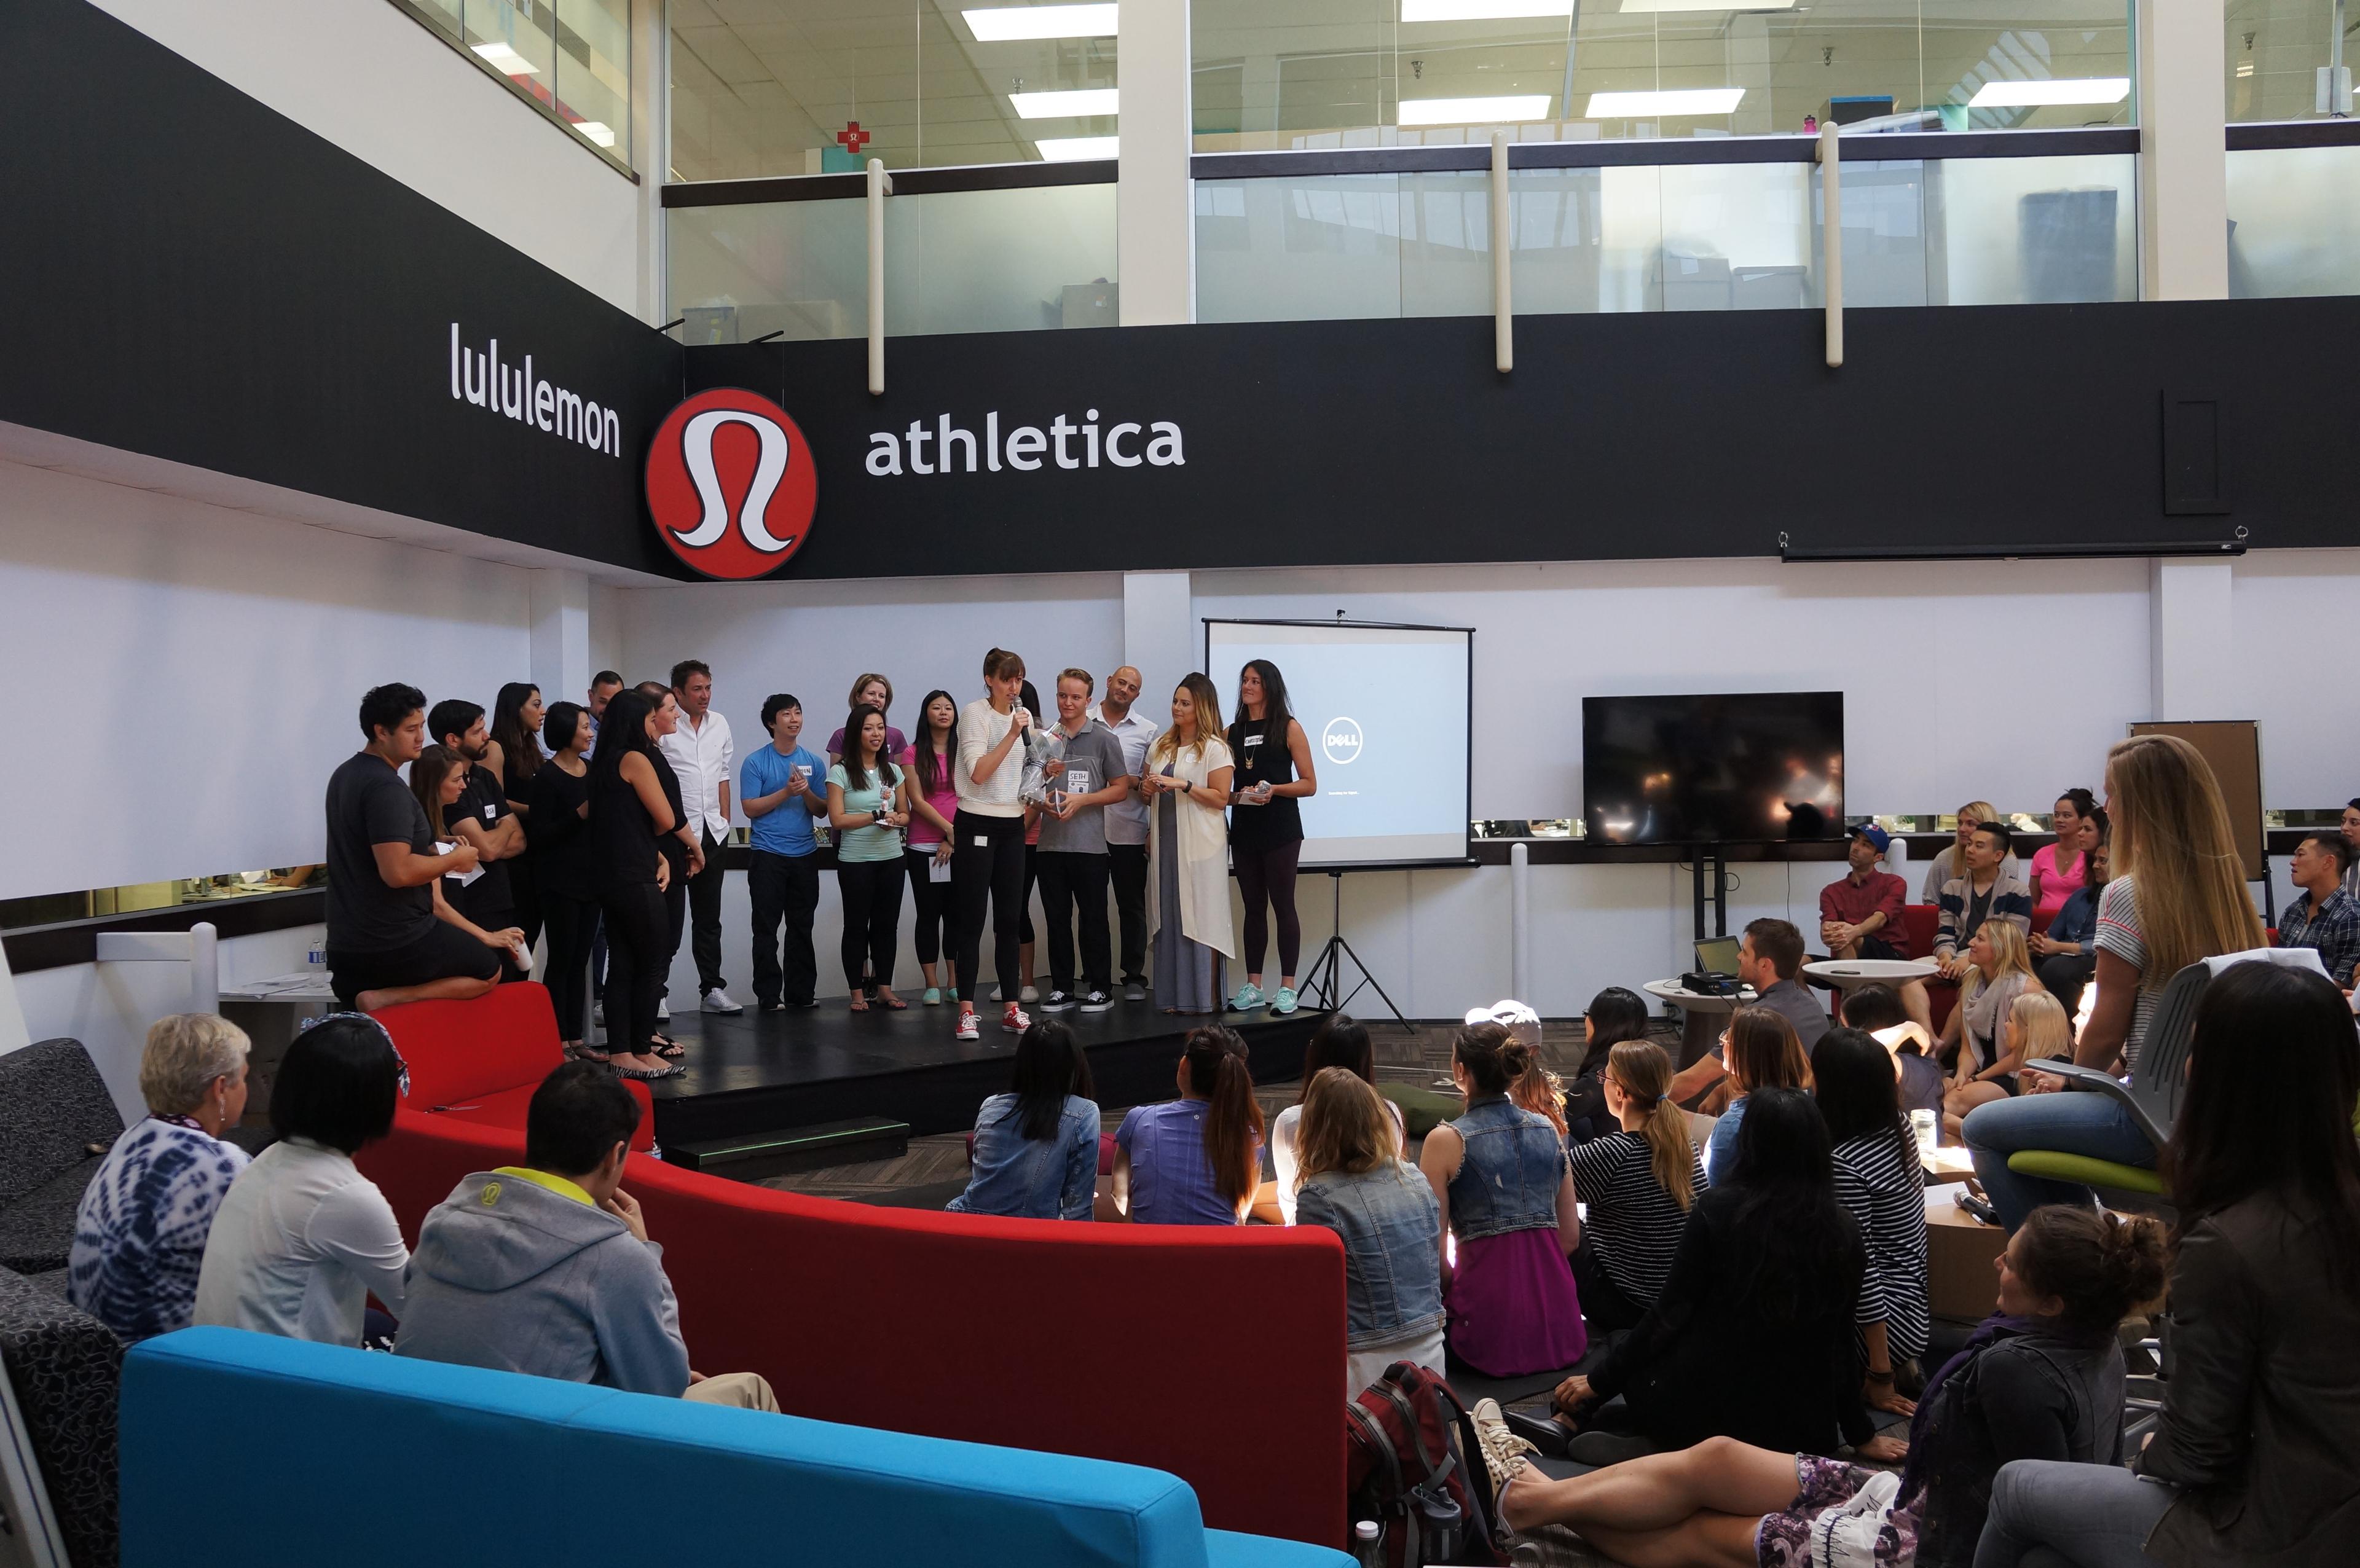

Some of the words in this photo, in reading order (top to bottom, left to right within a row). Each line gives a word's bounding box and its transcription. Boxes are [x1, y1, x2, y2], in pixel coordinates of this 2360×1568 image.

[452, 323, 619, 457] lululemon
[866, 409, 1185, 476] athletica
[1328, 734, 1358, 747] DELL
